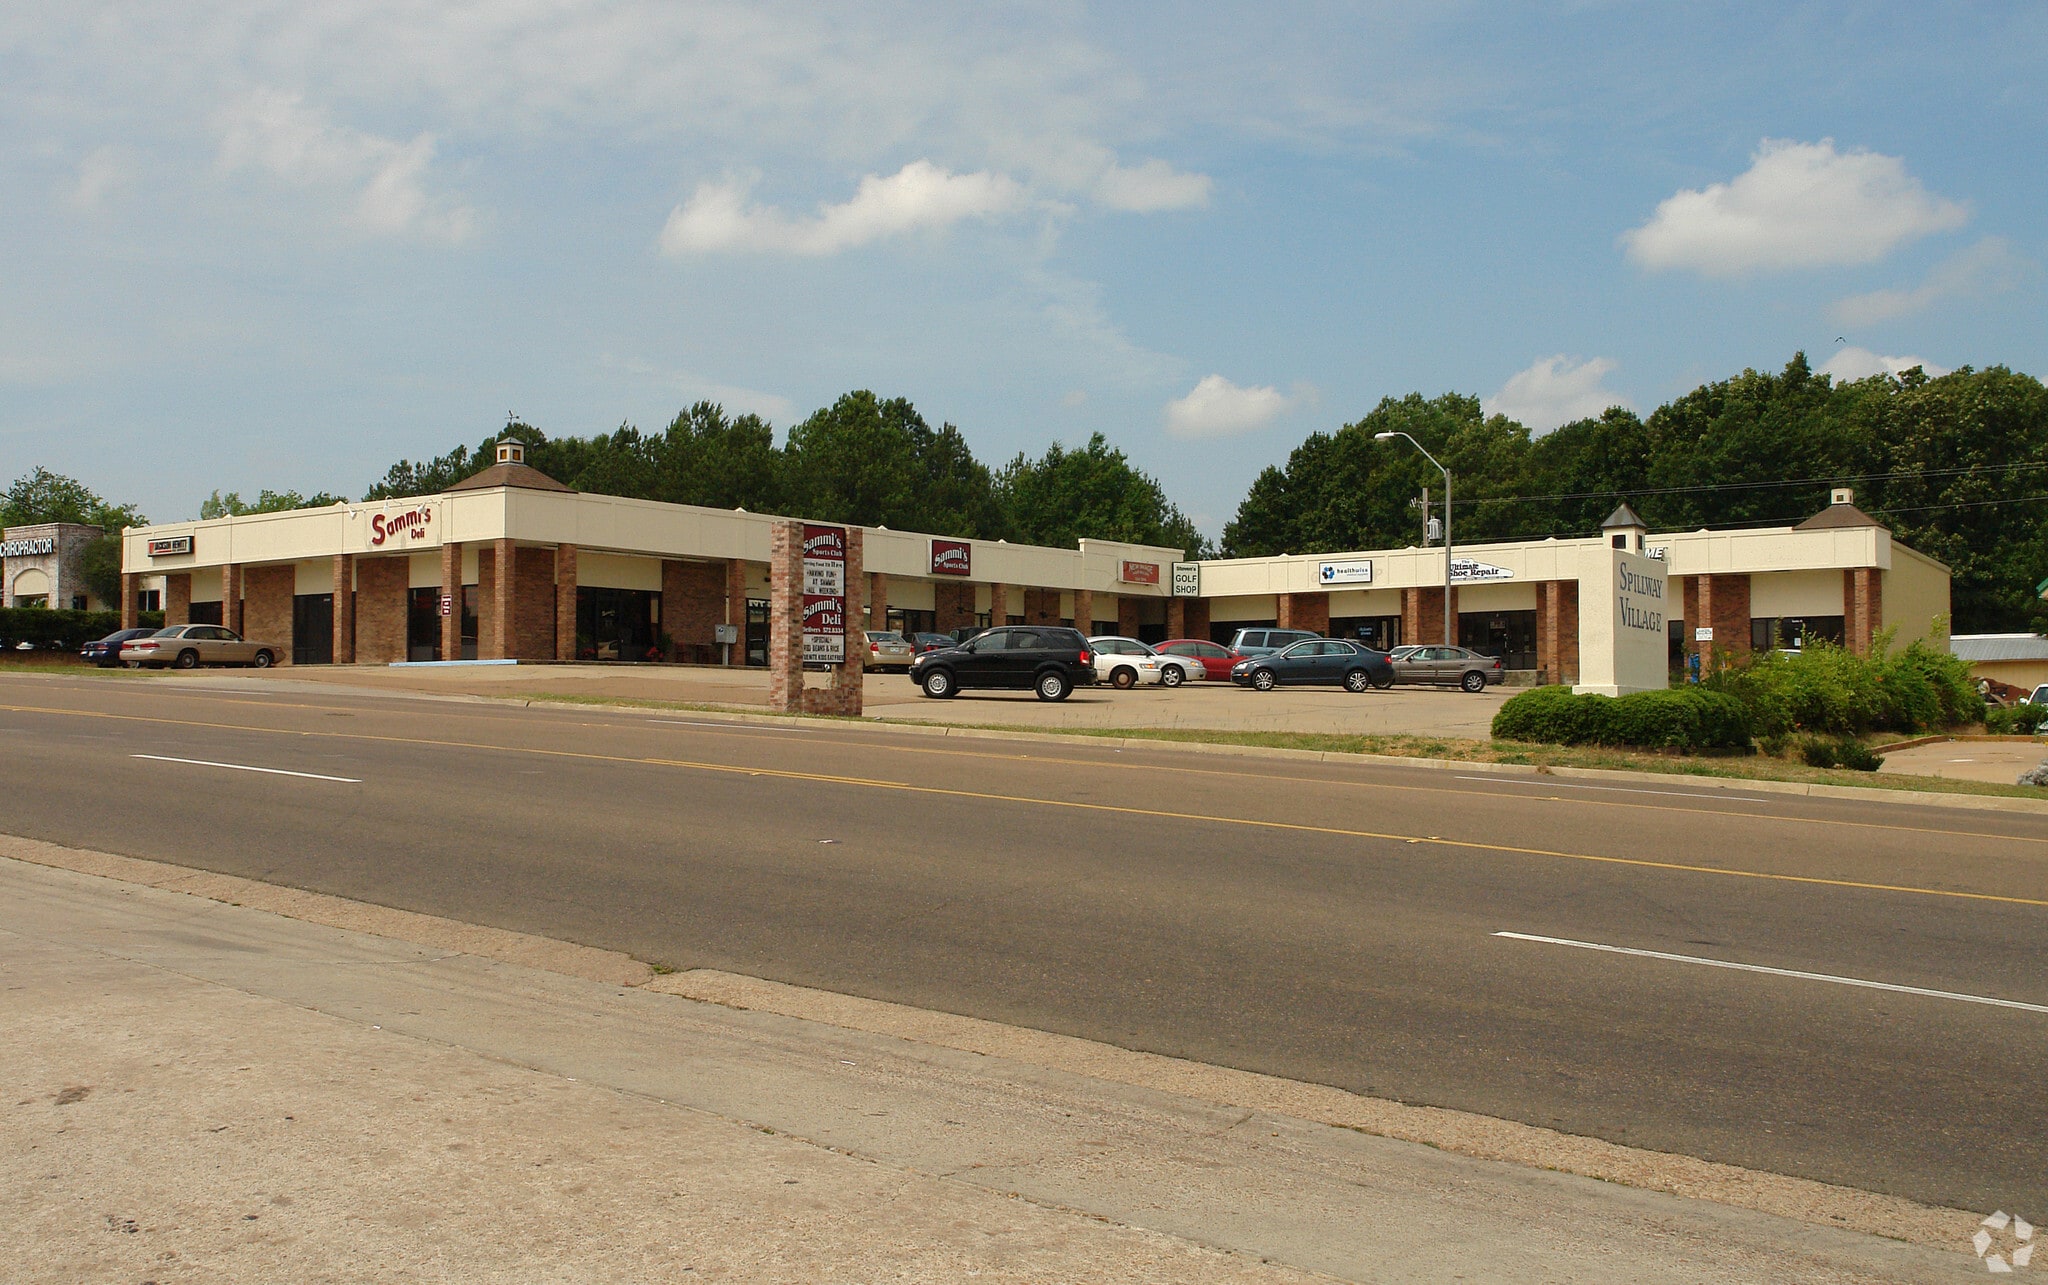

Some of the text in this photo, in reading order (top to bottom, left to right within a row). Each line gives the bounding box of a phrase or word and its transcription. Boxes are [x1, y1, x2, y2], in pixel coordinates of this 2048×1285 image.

[371, 508, 431, 545] Sammis
[410, 528, 425, 539] Deli
[0, 538, 52, 557] CHIROPRACTOR
[803, 533, 842, 554] Sammi's
[934, 547, 968, 567] Sammi's
[1470, 568, 1499, 576] Repair
[1175, 585, 1197, 593] SHOP
[803, 598, 842, 620] Sammi's
[822, 613, 841, 625] Deli
